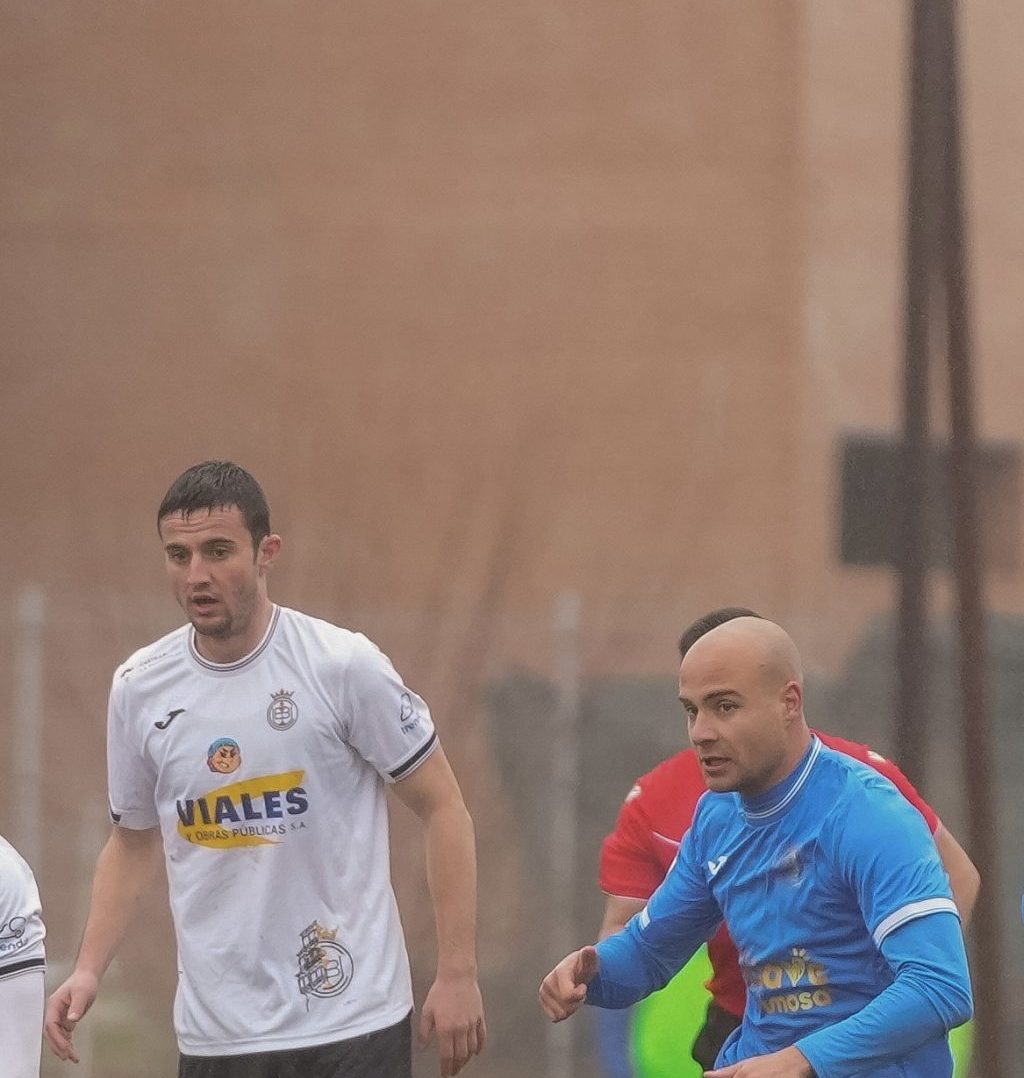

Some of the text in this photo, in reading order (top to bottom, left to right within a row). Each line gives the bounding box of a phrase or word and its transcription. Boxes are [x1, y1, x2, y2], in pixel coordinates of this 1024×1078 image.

[176, 786, 308, 827] VIALES
[195, 830, 229, 841] OBRAS
[232, 824, 286, 838] PÚBLICAS
